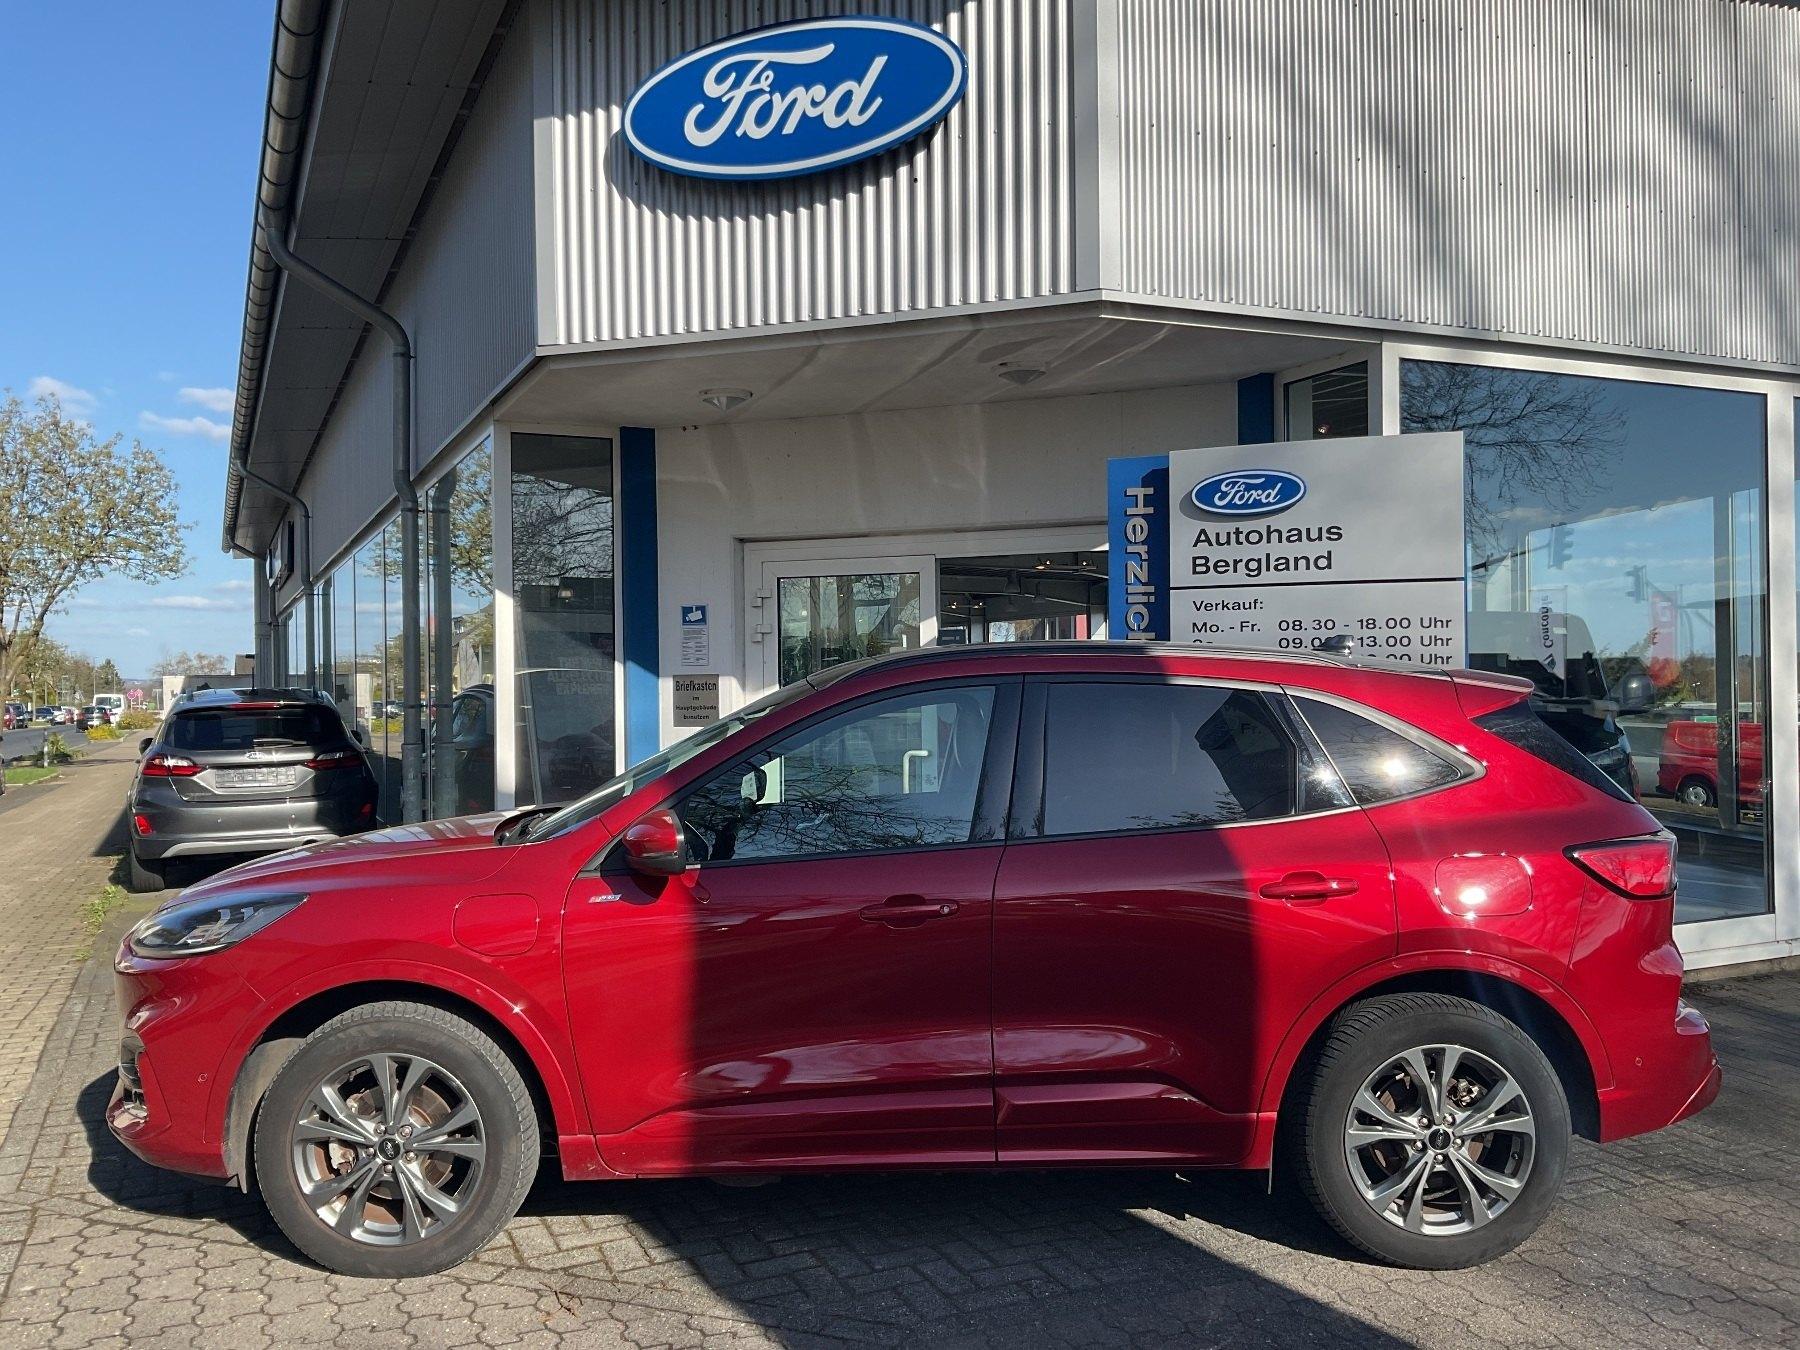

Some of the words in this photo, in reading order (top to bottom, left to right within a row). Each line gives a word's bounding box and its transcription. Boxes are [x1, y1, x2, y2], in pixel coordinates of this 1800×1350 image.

[684, 43, 888, 147] Ford
[1214, 478, 1282, 506] Ford
[1192, 525, 1343, 547] Autohaus
[1191, 550, 1332, 578] Bergland
[1192, 598, 1264, 612] Verkauf:
[1192, 621, 1225, 633] Mo.
[1240, 620, 1261, 632] Fr.
[1278, 619, 1336, 631] 08.30
[1357, 617, 1412, 630] 18.00
[1420, 617, 1453, 629] Uhr
[1357, 635, 1412, 648] 13.00
[1420, 635, 1453, 647] Uhr
[1420, 653, 1453, 665] Uhr
[675, 680, 717, 692] Briefkasten
